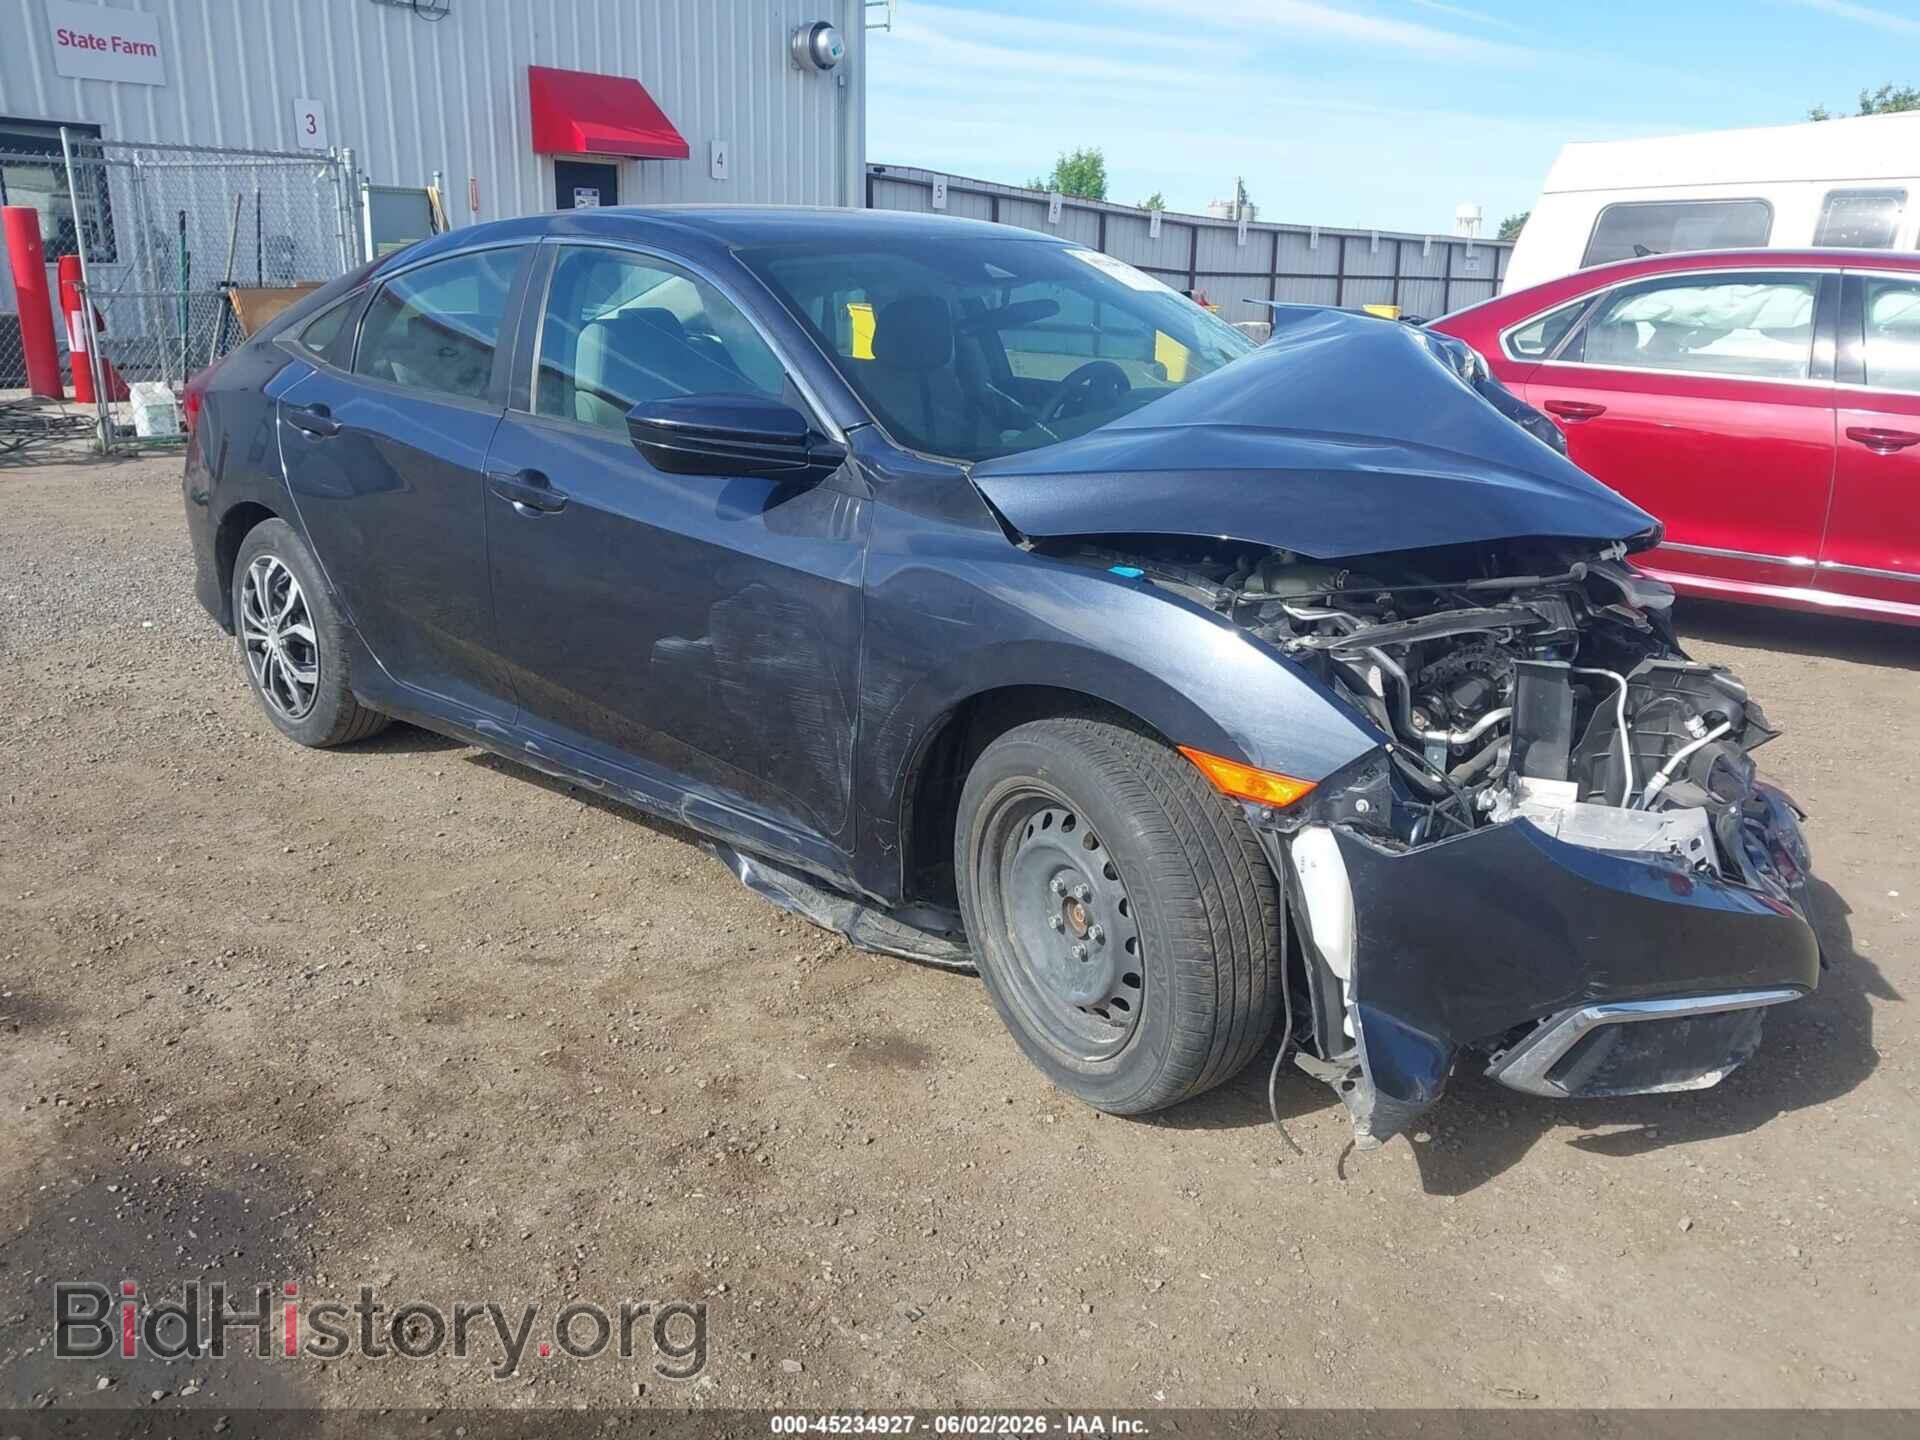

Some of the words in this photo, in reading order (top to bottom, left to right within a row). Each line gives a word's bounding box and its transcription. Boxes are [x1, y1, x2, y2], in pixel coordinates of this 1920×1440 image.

[56, 28, 107, 51] State
[110, 36, 157, 57] Farm
[305, 113, 317, 135] 3
[716, 152, 724, 169] 4
